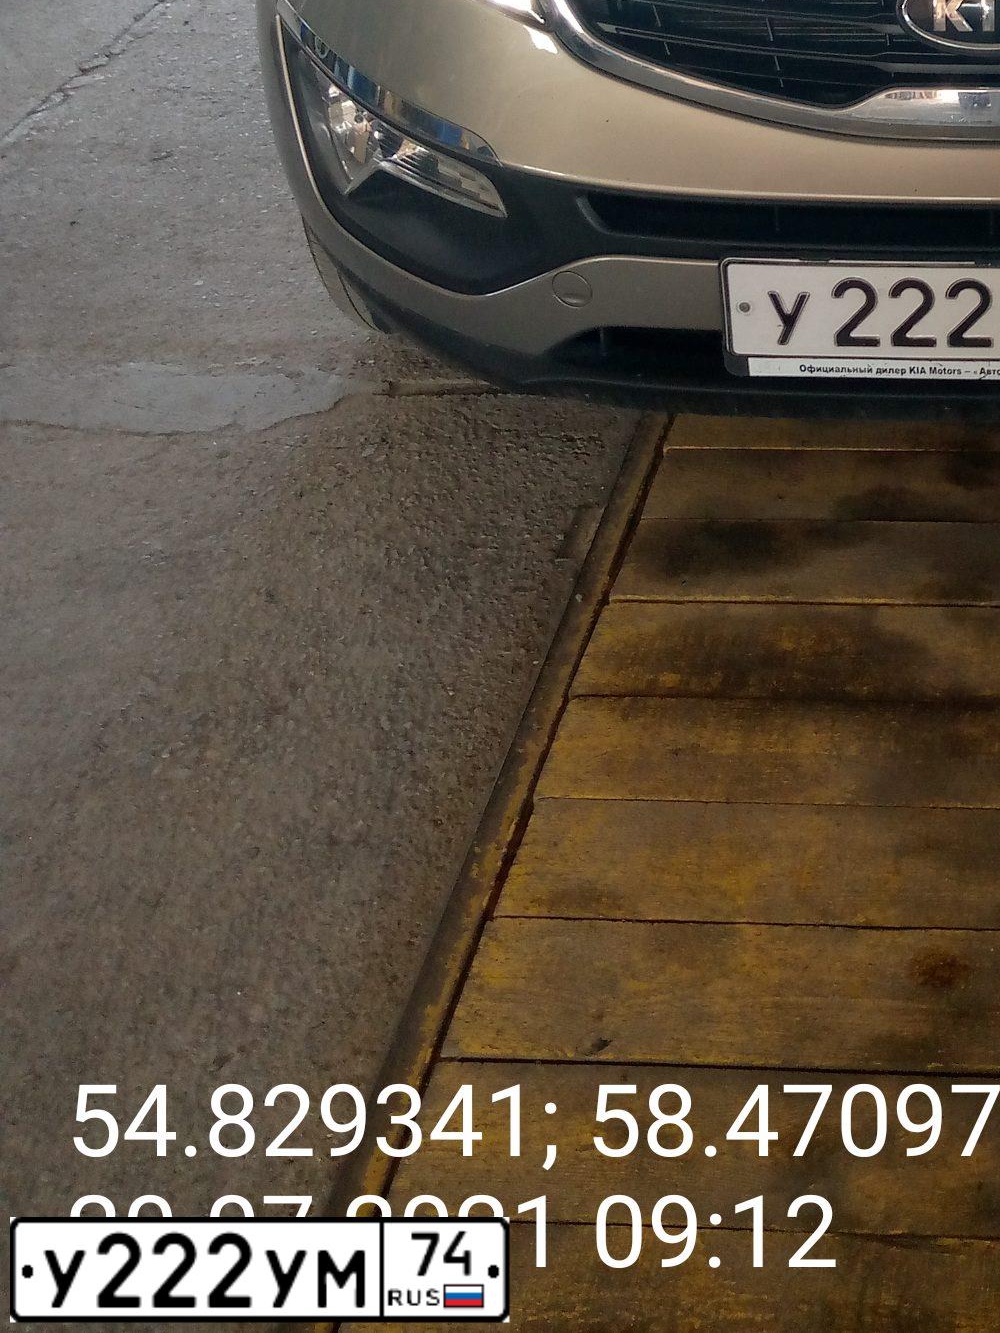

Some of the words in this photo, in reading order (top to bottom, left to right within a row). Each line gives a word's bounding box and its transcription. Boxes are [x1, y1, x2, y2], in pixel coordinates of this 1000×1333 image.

[799, 363, 873, 374] Официальный
[876, 366, 907, 376] дилер
[909, 366, 927, 375] KIA
[929, 366, 962, 375] Motors
